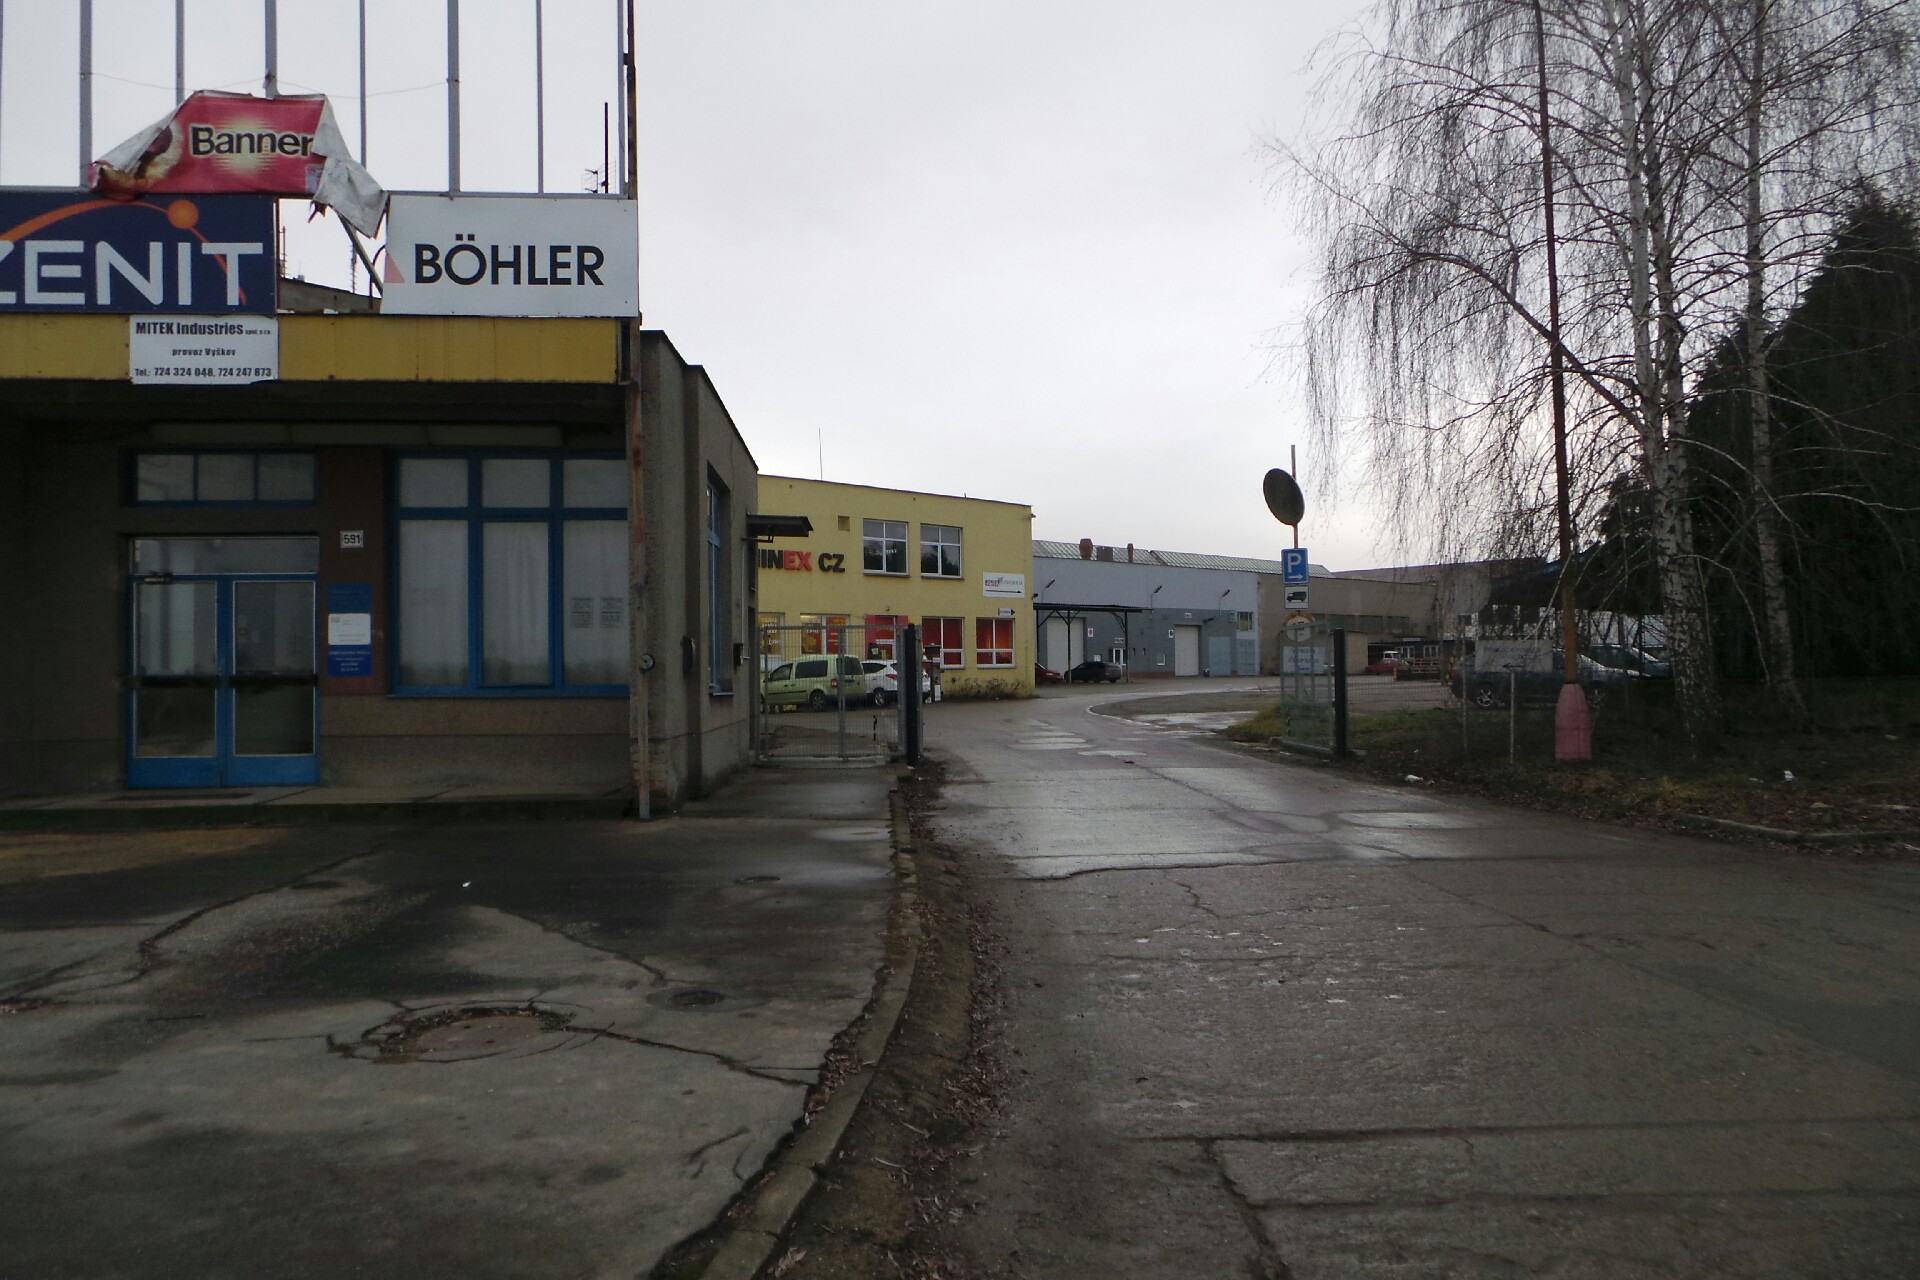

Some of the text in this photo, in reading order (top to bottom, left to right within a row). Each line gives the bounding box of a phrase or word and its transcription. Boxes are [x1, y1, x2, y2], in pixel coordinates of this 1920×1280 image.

[191, 126, 314, 156] Banner
[414, 233, 605, 285] BÖHLER
[135, 322, 174, 335] MITEK
[176, 322, 244, 335] Industries
[172, 347, 236, 357] provoz Vyškov
[154, 367, 171, 377] 724
[173, 367, 191, 377] 324
[218, 367, 233, 377] 724
[236, 367, 252, 377] 247
[343, 534, 361, 544] 591
[758, 549, 846, 573] INEX CZ
[1287, 552, 1303, 573] P
